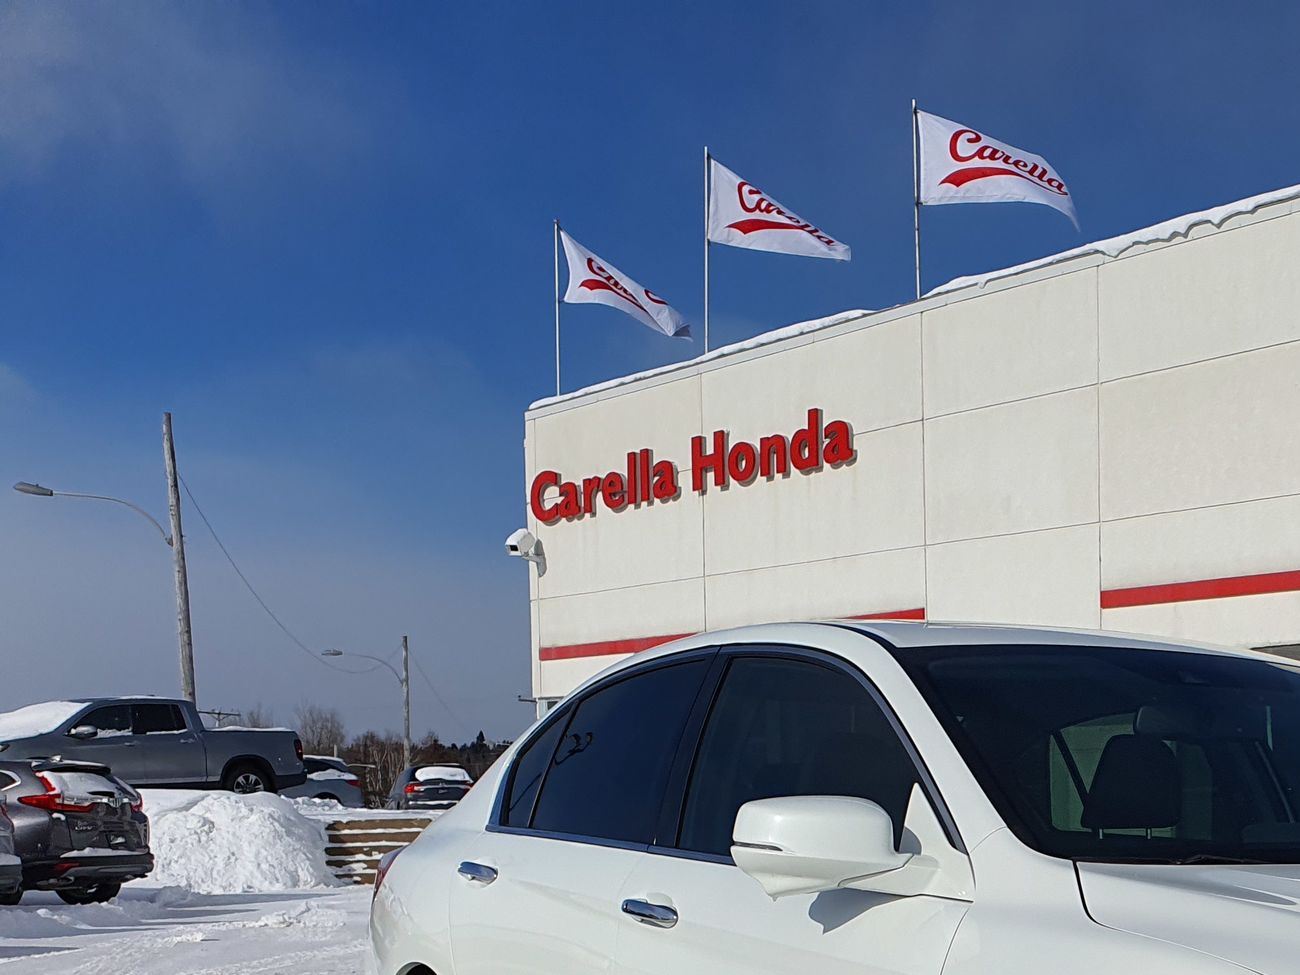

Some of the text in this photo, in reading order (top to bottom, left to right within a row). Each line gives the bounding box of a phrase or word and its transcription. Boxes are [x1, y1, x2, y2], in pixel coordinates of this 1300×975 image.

[949, 129, 1068, 194] Carella
[530, 408, 854, 523] Carella Honda
